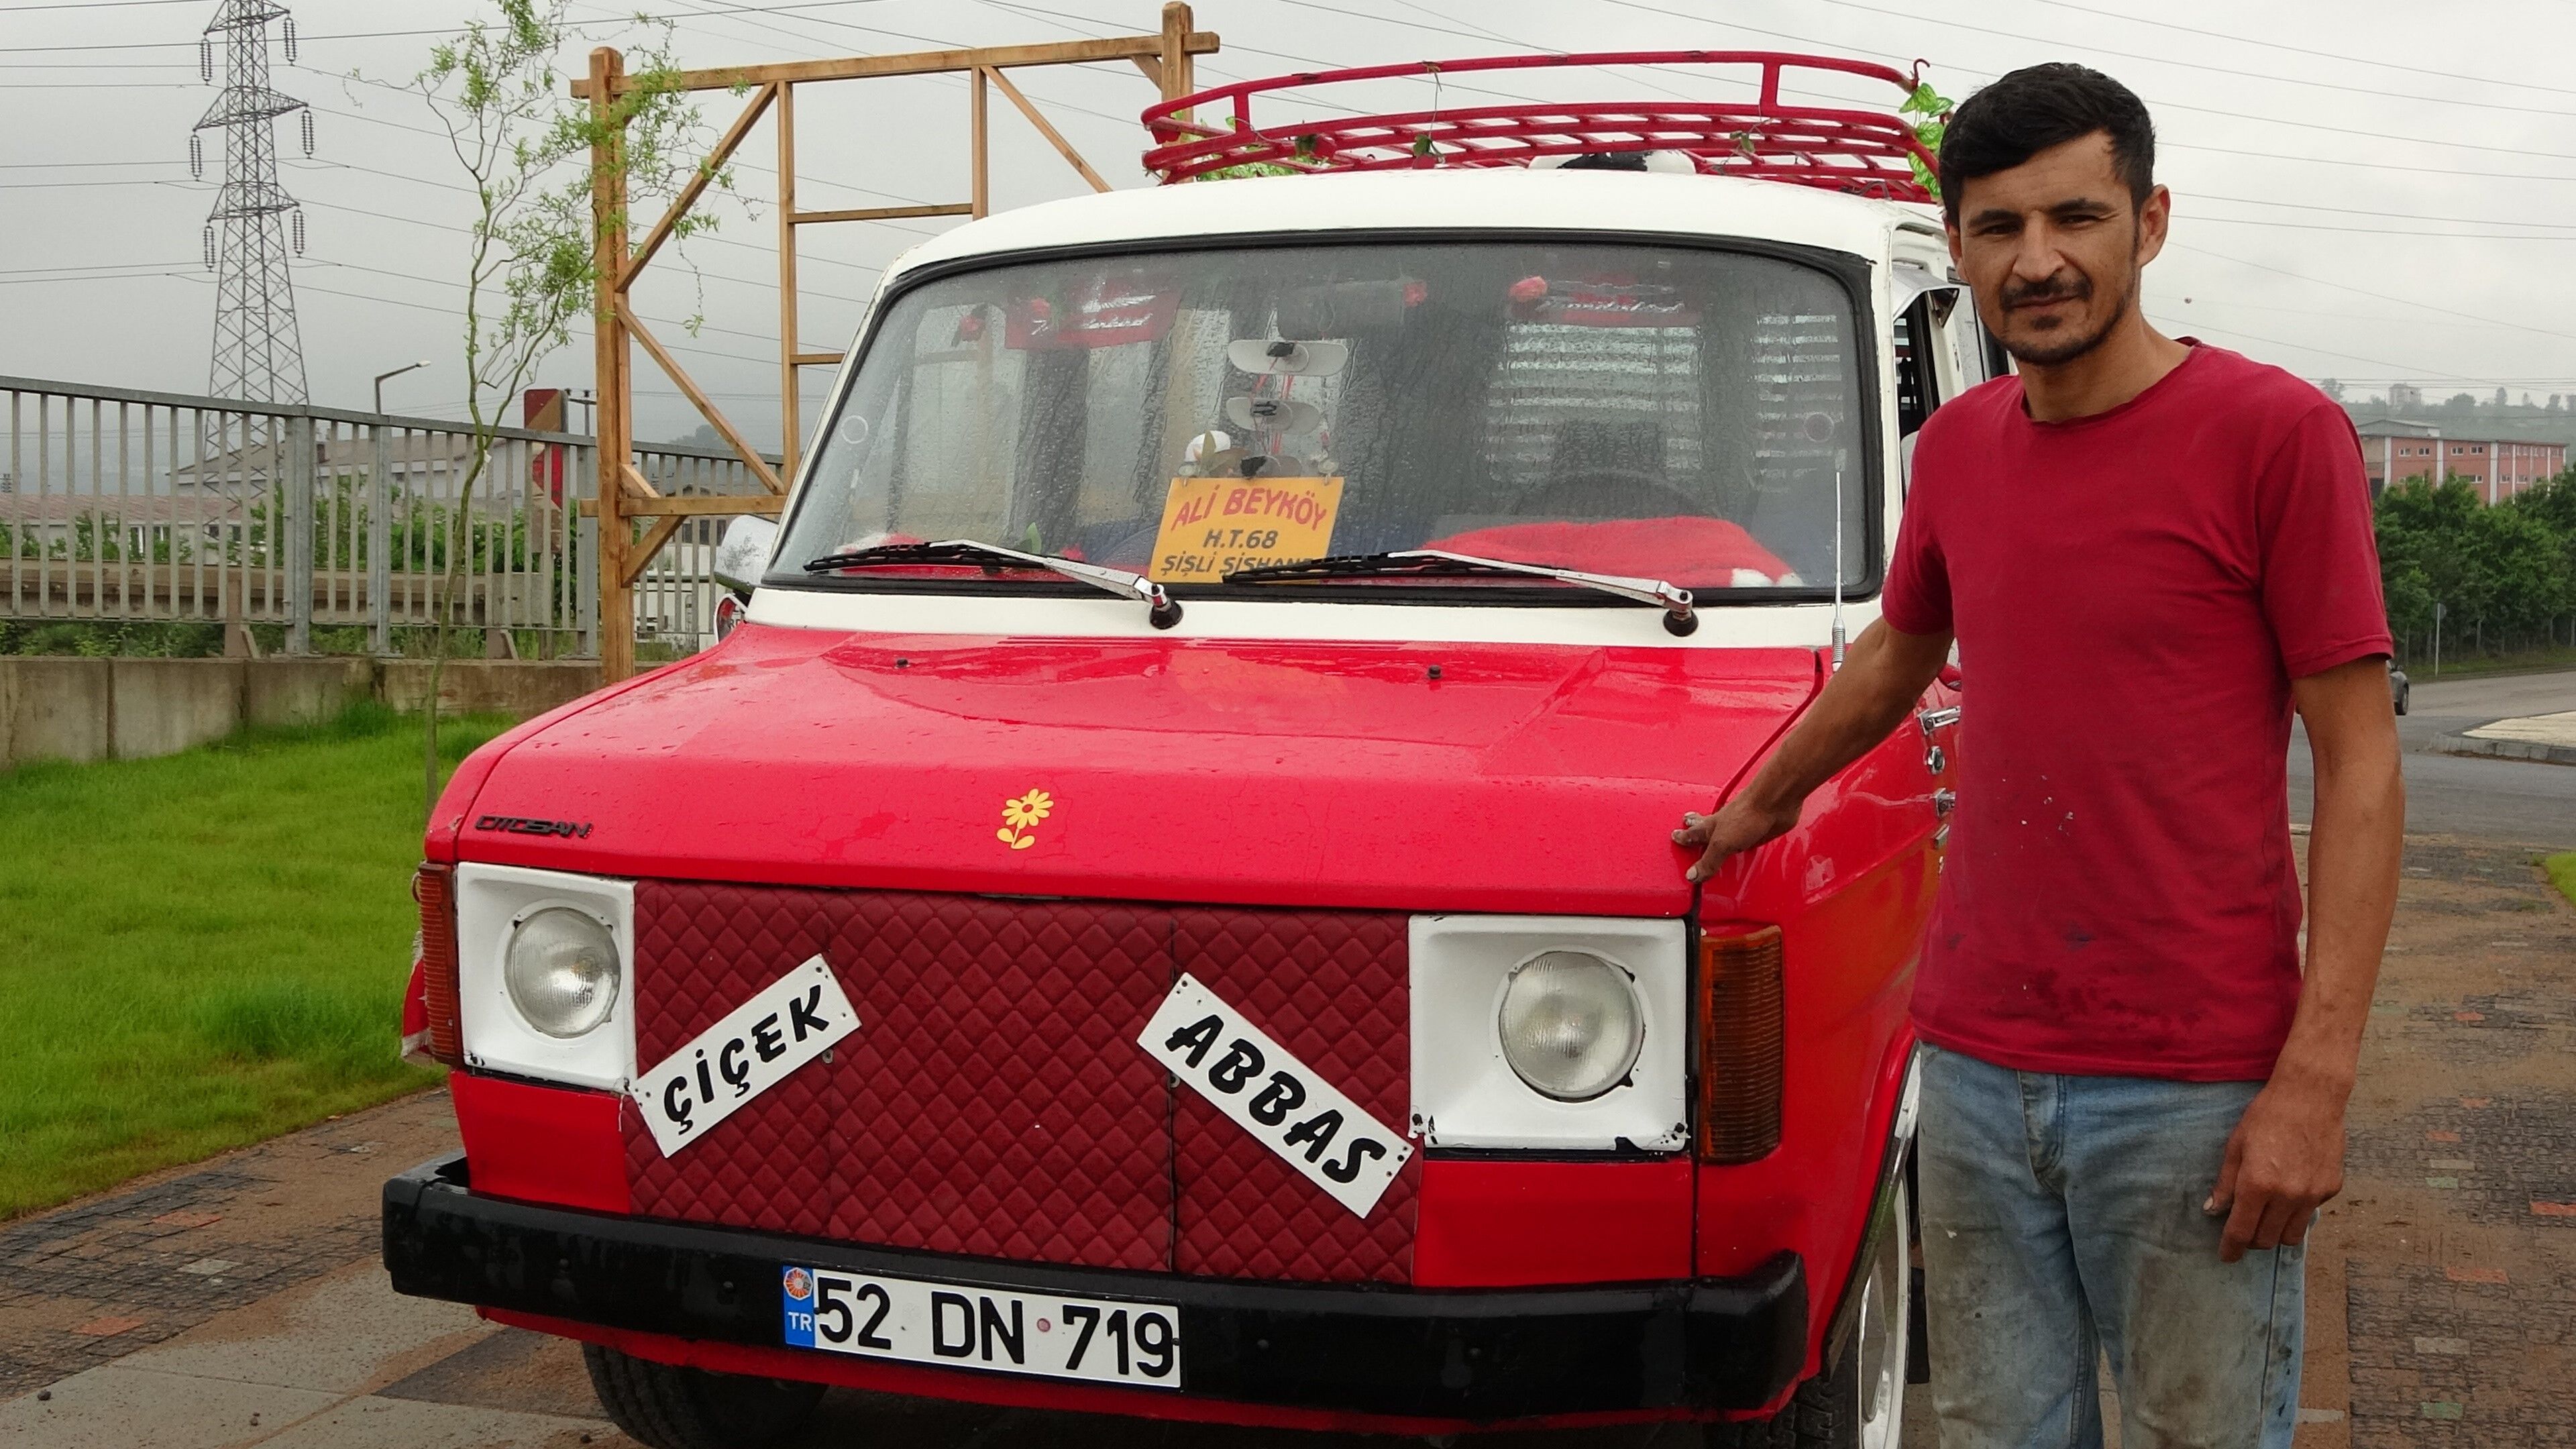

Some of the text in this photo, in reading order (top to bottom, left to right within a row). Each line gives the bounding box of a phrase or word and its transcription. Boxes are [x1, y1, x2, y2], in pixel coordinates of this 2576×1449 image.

[1171, 484, 1326, 531] ALİ BEYKÖY
[1203, 529, 1278, 549] H.T.68
[1161, 551, 1217, 576] ŞİŞLİ
[475, 814, 593, 838] OTOSAN
[664, 984, 829, 1135] ÇİÇEK
[1165, 1014, 1387, 1183] ABBAS
[788, 1311, 812, 1332] TR
[817, 1277, 1174, 1378] 52 DN 719
